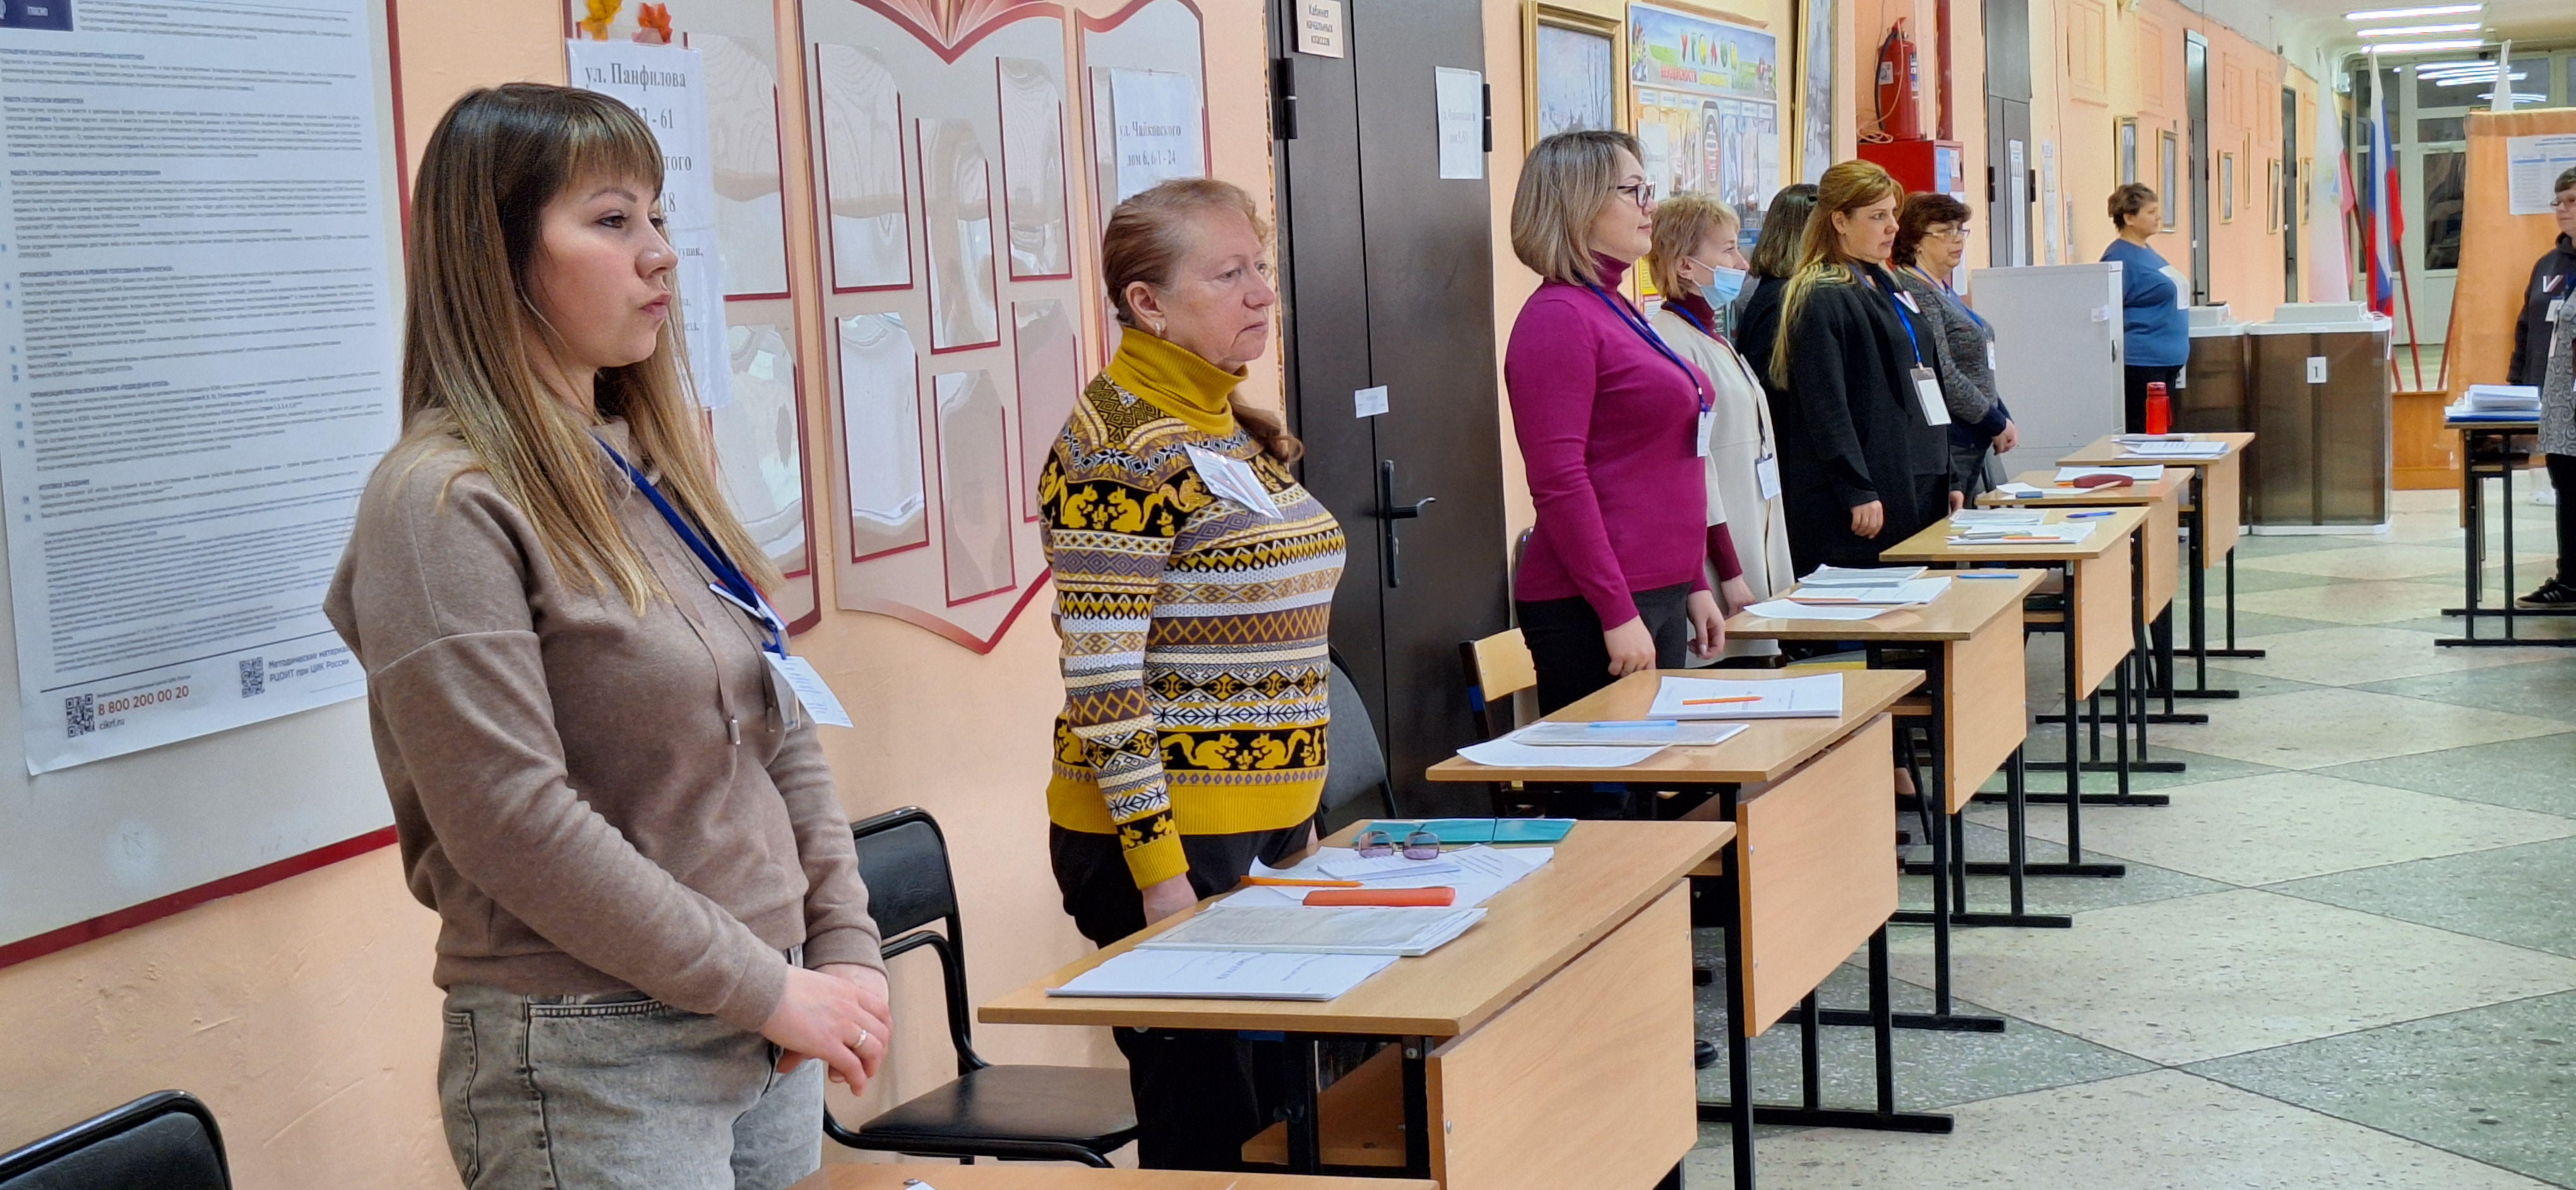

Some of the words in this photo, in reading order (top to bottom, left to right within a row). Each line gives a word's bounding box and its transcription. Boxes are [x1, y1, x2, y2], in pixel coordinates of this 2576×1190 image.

[585, 67, 606, 88] ул.
[611, 63, 686, 92] Панфилова
[661, 108, 673, 129] 61
[1132, 121, 1181, 136] Чайковского
[664, 156, 691, 171] того
[2313, 366, 2320, 378] 1
[269, 653, 317, 669] Методические
[319, 646, 350, 657] материал
[296, 669, 309, 677] при
[310, 664, 325, 673] ЦИК
[326, 658, 349, 670] России
[98, 704, 105, 715] 8
[109, 699, 129, 714] 800
[133, 693, 154, 708] 200
[157, 689, 172, 702] 00
[176, 685, 189, 699] 20
